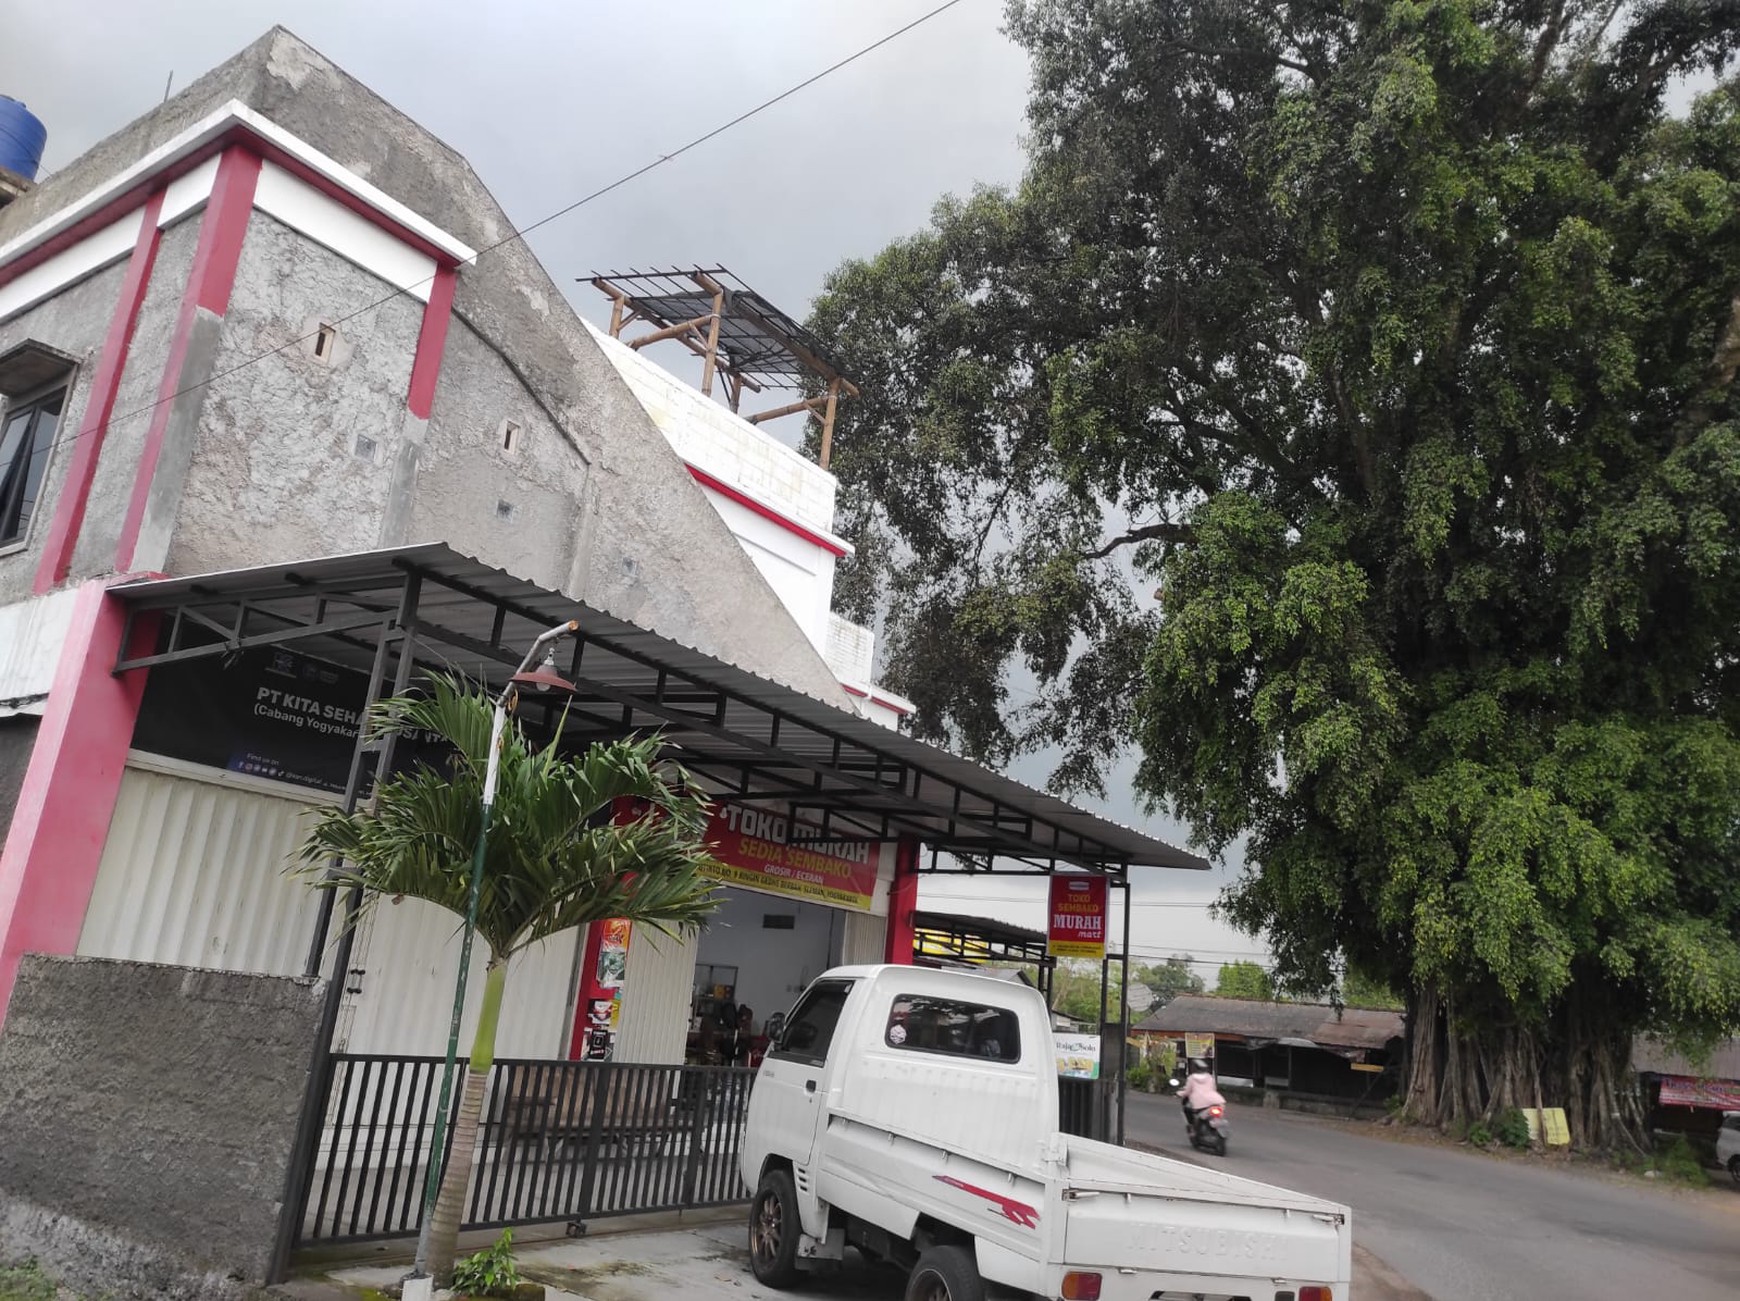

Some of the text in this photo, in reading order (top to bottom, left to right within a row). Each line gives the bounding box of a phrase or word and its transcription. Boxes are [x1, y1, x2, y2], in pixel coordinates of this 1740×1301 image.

[257, 686, 282, 704] PT
[282, 694, 320, 715] KITA
[253, 702, 304, 727] (Cabang
[727, 803, 788, 844] TOKO
[738, 838, 852, 879] SEDIA SEMBAKO
[764, 863, 792, 878] GROSIR
[1057, 902, 1100, 914] SEMBAKO
[1068, 893, 1091, 903] TOKO
[1053, 914, 1102, 930] MURAH
[1125, 1222, 1289, 1261] MITSUBISHI
